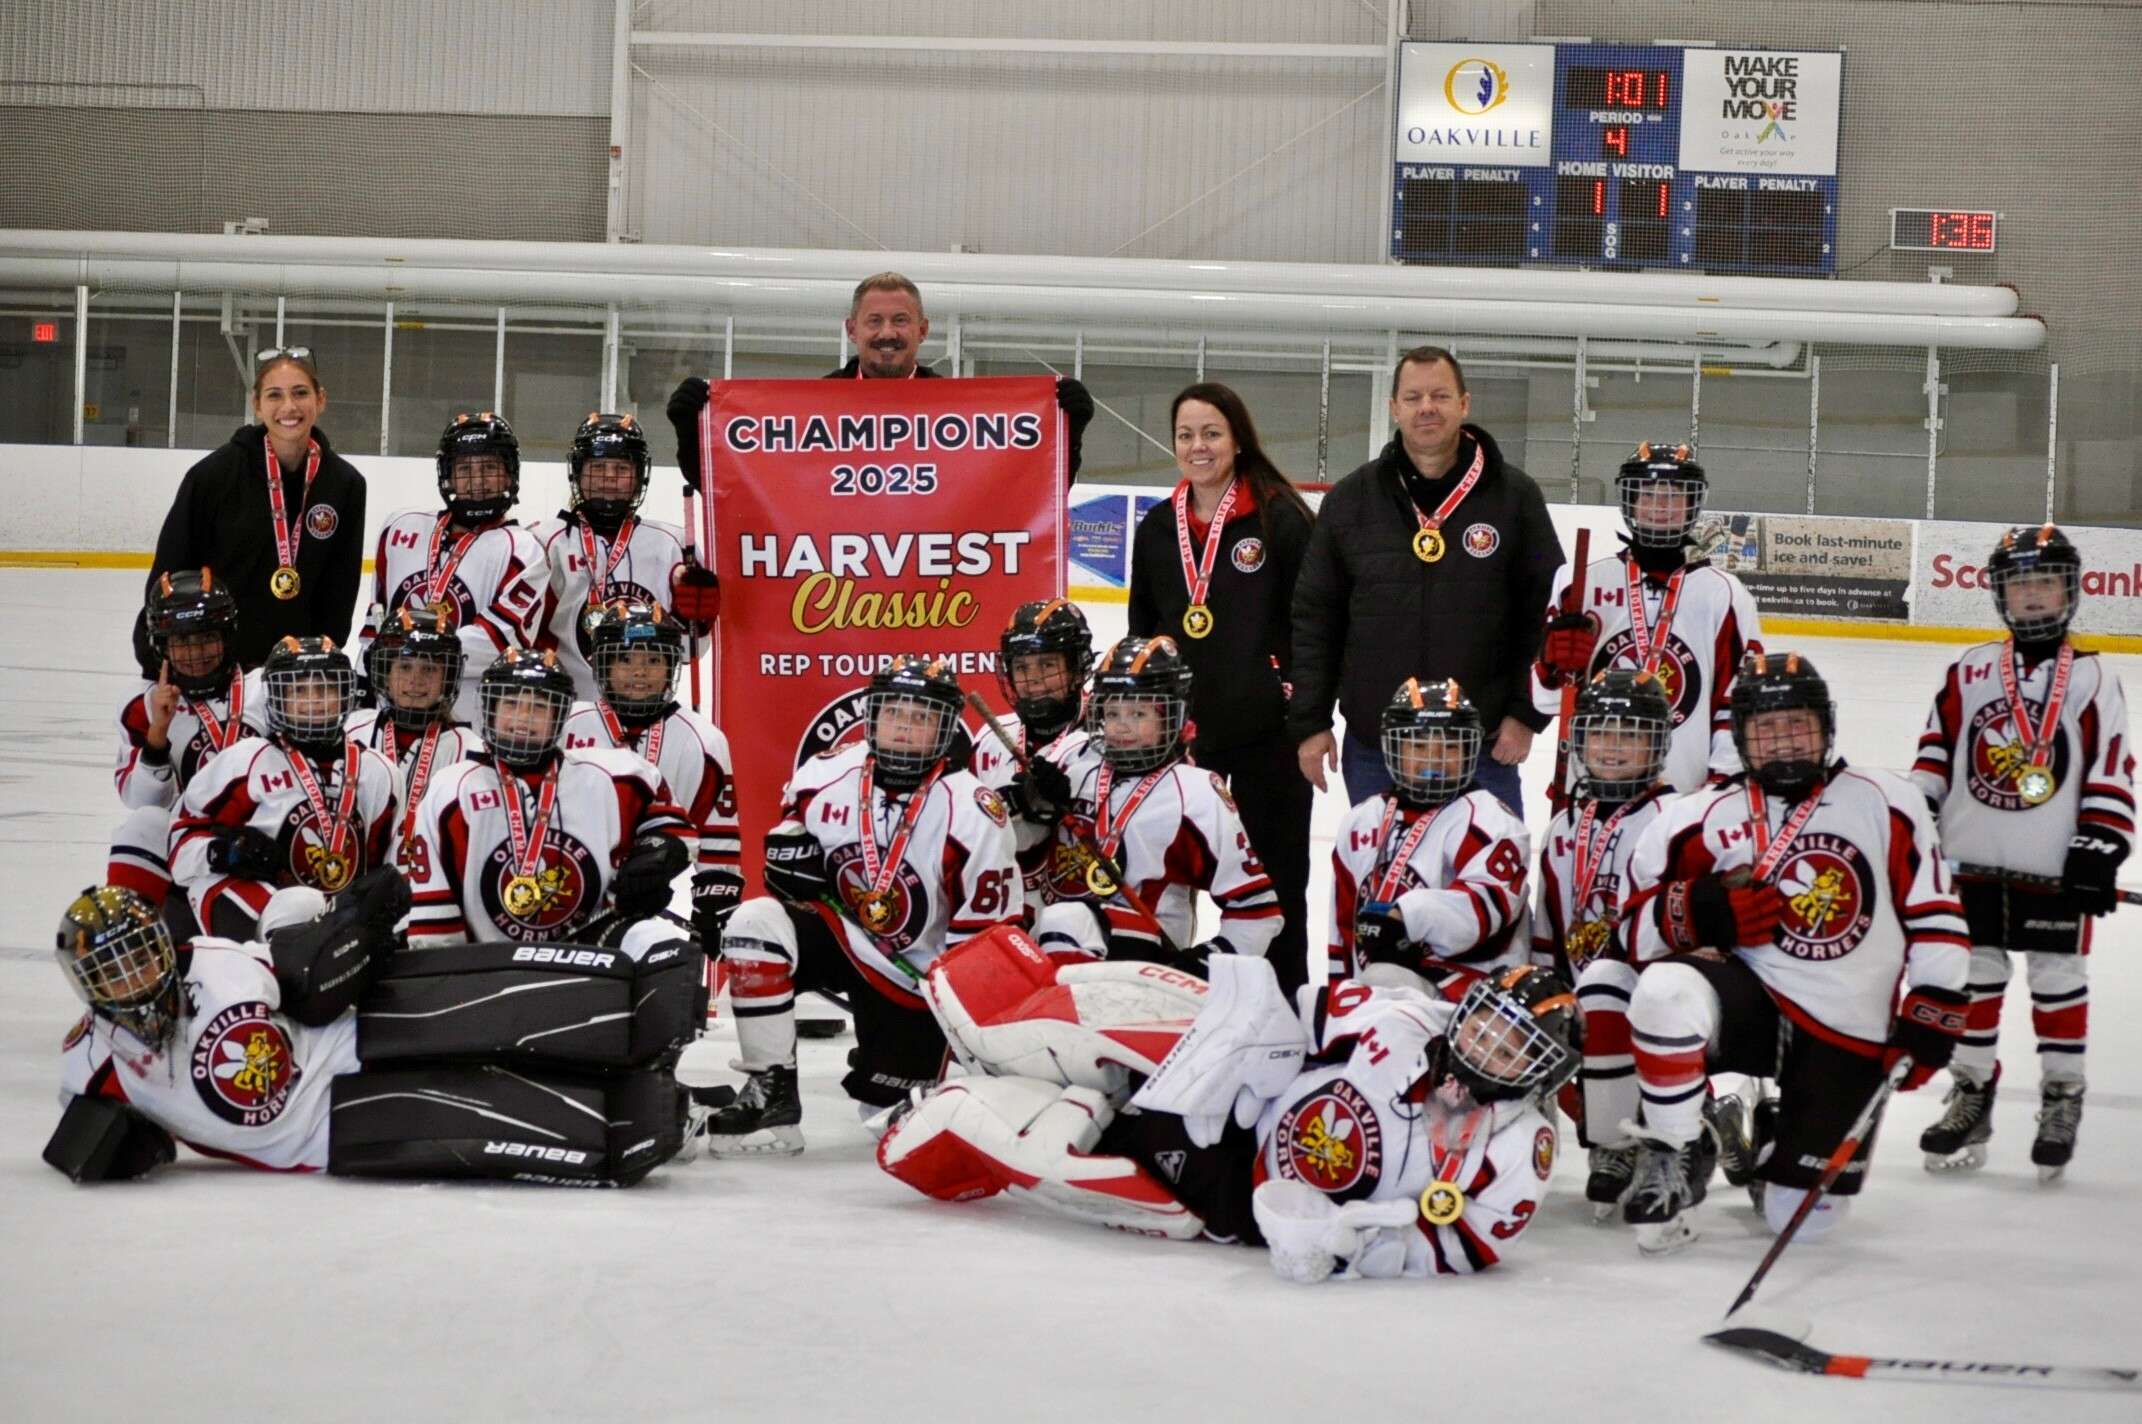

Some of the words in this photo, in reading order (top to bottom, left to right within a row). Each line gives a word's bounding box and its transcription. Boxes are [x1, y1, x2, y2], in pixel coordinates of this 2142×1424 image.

[1724, 55, 1799, 78] MAKE
[1725, 77, 1797, 100] YOUR
[1589, 111, 1643, 124] PERIOD
[1407, 126, 1542, 148] OAKVILLE
[1605, 127, 1629, 157] 4
[1402, 167, 1455, 180] PLAYER
[1463, 169, 1521, 182] PENALTY
[1557, 161, 1607, 177] HOME
[1612, 163, 1674, 180] VISITOR
[1694, 176, 1748, 190] PLAYER
[1759, 178, 1818, 192] PENALTY
[1533, 196, 1541, 206] 3
[1683, 201, 1692, 211] 3
[1531, 222, 1540, 232] 4
[1682, 227, 1691, 237] 4
[725, 413, 1042, 453] CHAMPIONS
[830, 464, 937, 495] 2025
[1775, 533, 1812, 546] Book
[1817, 534, 1903, 550] last-minute
[739, 531, 1031, 579] HARVEST
[1774, 550, 1796, 563] ice
[1800, 552, 1828, 564] and
[1832, 554, 1873, 567] save!
[791, 571, 981, 635] Classic
[759, 653, 812, 677] REP
[821, 651, 1008, 677] TOURAMEN
[407, 736, 435, 813] CHAMPIONS
[1970, 778, 2032, 809] HORNE
[2069, 836, 2119, 854] CM
[1780, 914, 1871, 959] HORNETS
[512, 946, 616, 969] BAUER
[1138, 965, 1210, 996] CCM
[1912, 1003, 1966, 1030] CC
[193, 1003, 269, 1080] OAKVILLE
[1333, 1080, 1381, 1178] OAKVILLE
[484, 1141, 586, 1165] BAUER
